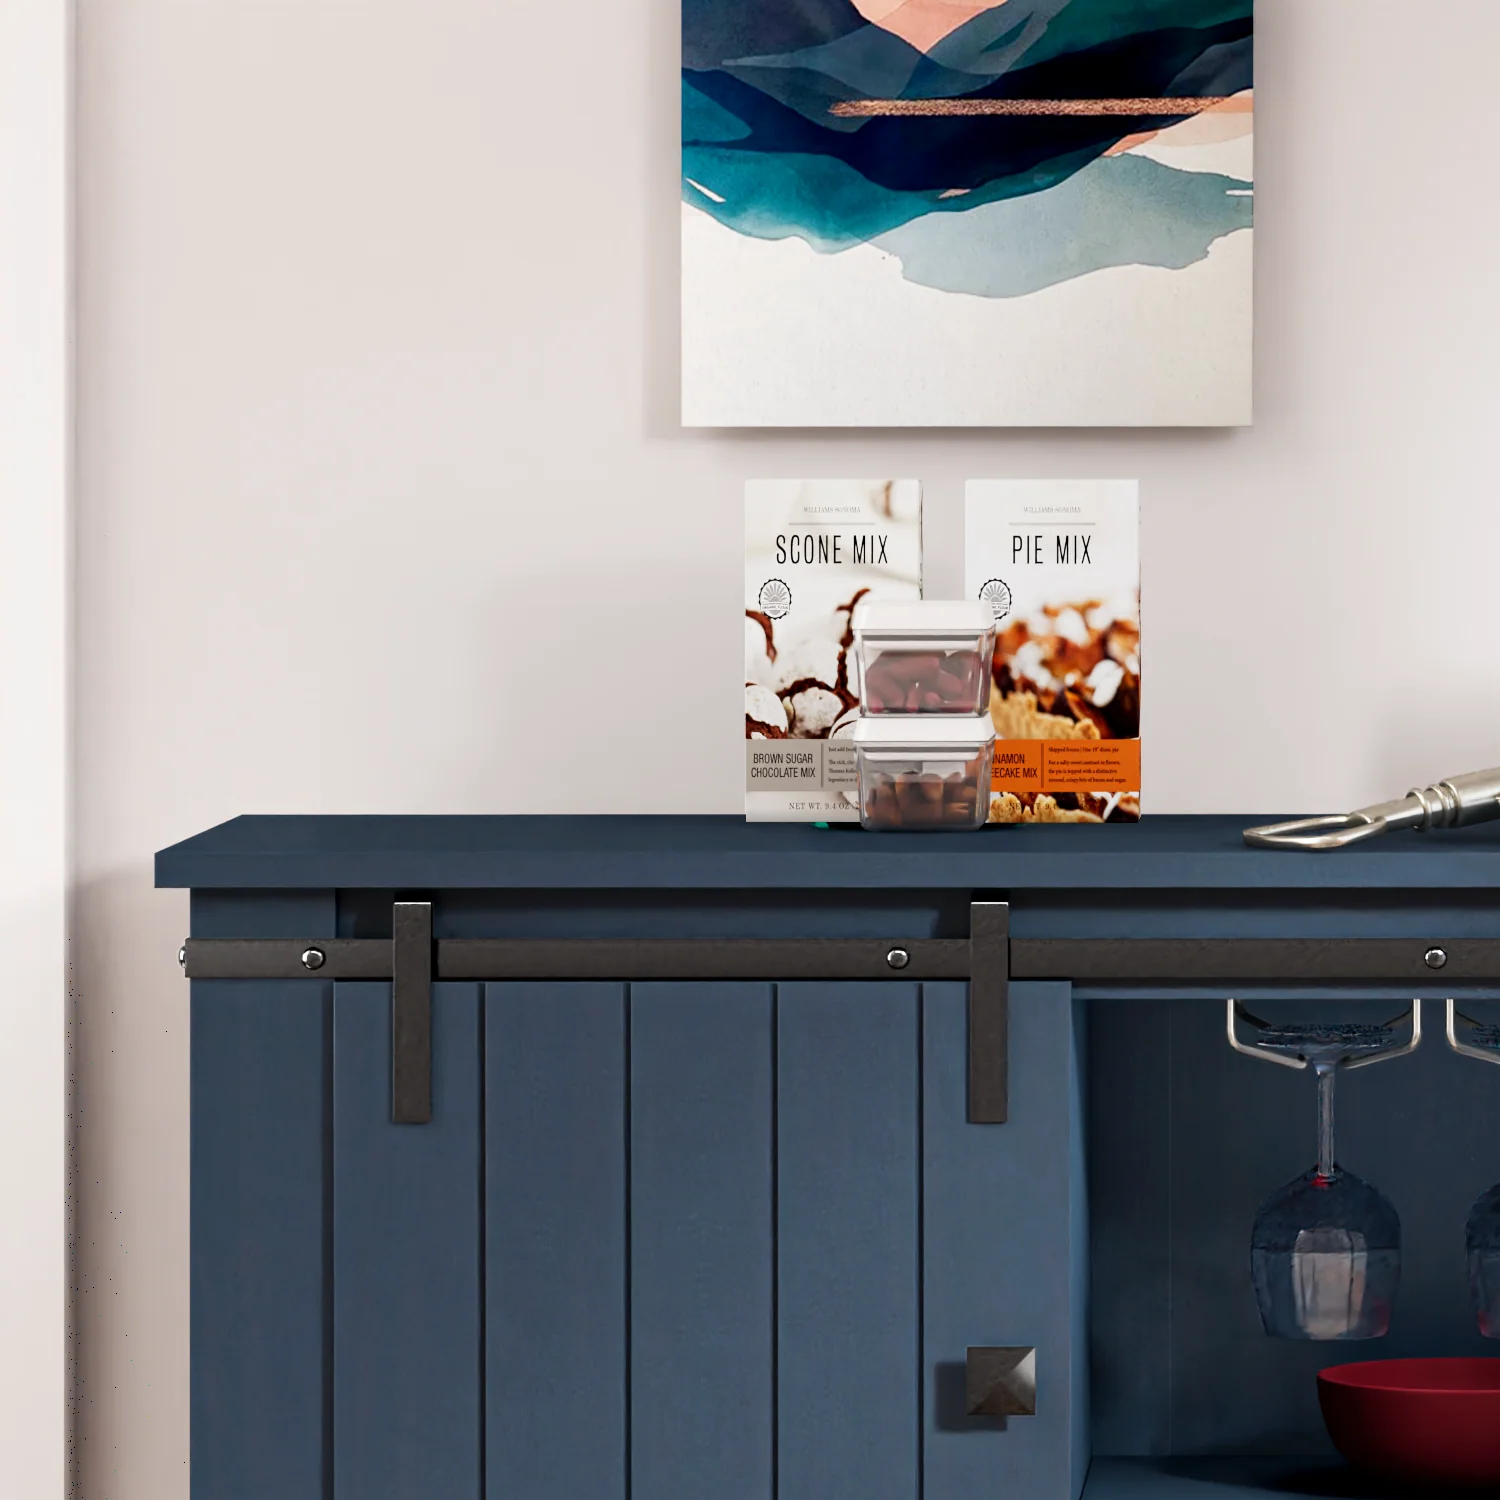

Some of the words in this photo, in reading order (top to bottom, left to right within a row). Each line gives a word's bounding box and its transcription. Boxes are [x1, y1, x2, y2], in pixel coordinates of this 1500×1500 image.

[776, 534, 842, 564] SCONE
[853, 534, 888, 564] MIX
[1012, 535, 1043, 564] PIE
[1056, 535, 1091, 564] MIX
[753, 753, 783, 764] BROWN
[786, 753, 813, 764] SUGAR
[751, 767, 798, 778] CHOCOLATE
[800, 767, 816, 778] MIX
[1022, 767, 1038, 778] MIX
[789, 802, 806, 810] NET
[808, 802, 823, 810] WT.
[825, 802, 837, 810] 9.4
[838, 802, 850, 810] OZ
